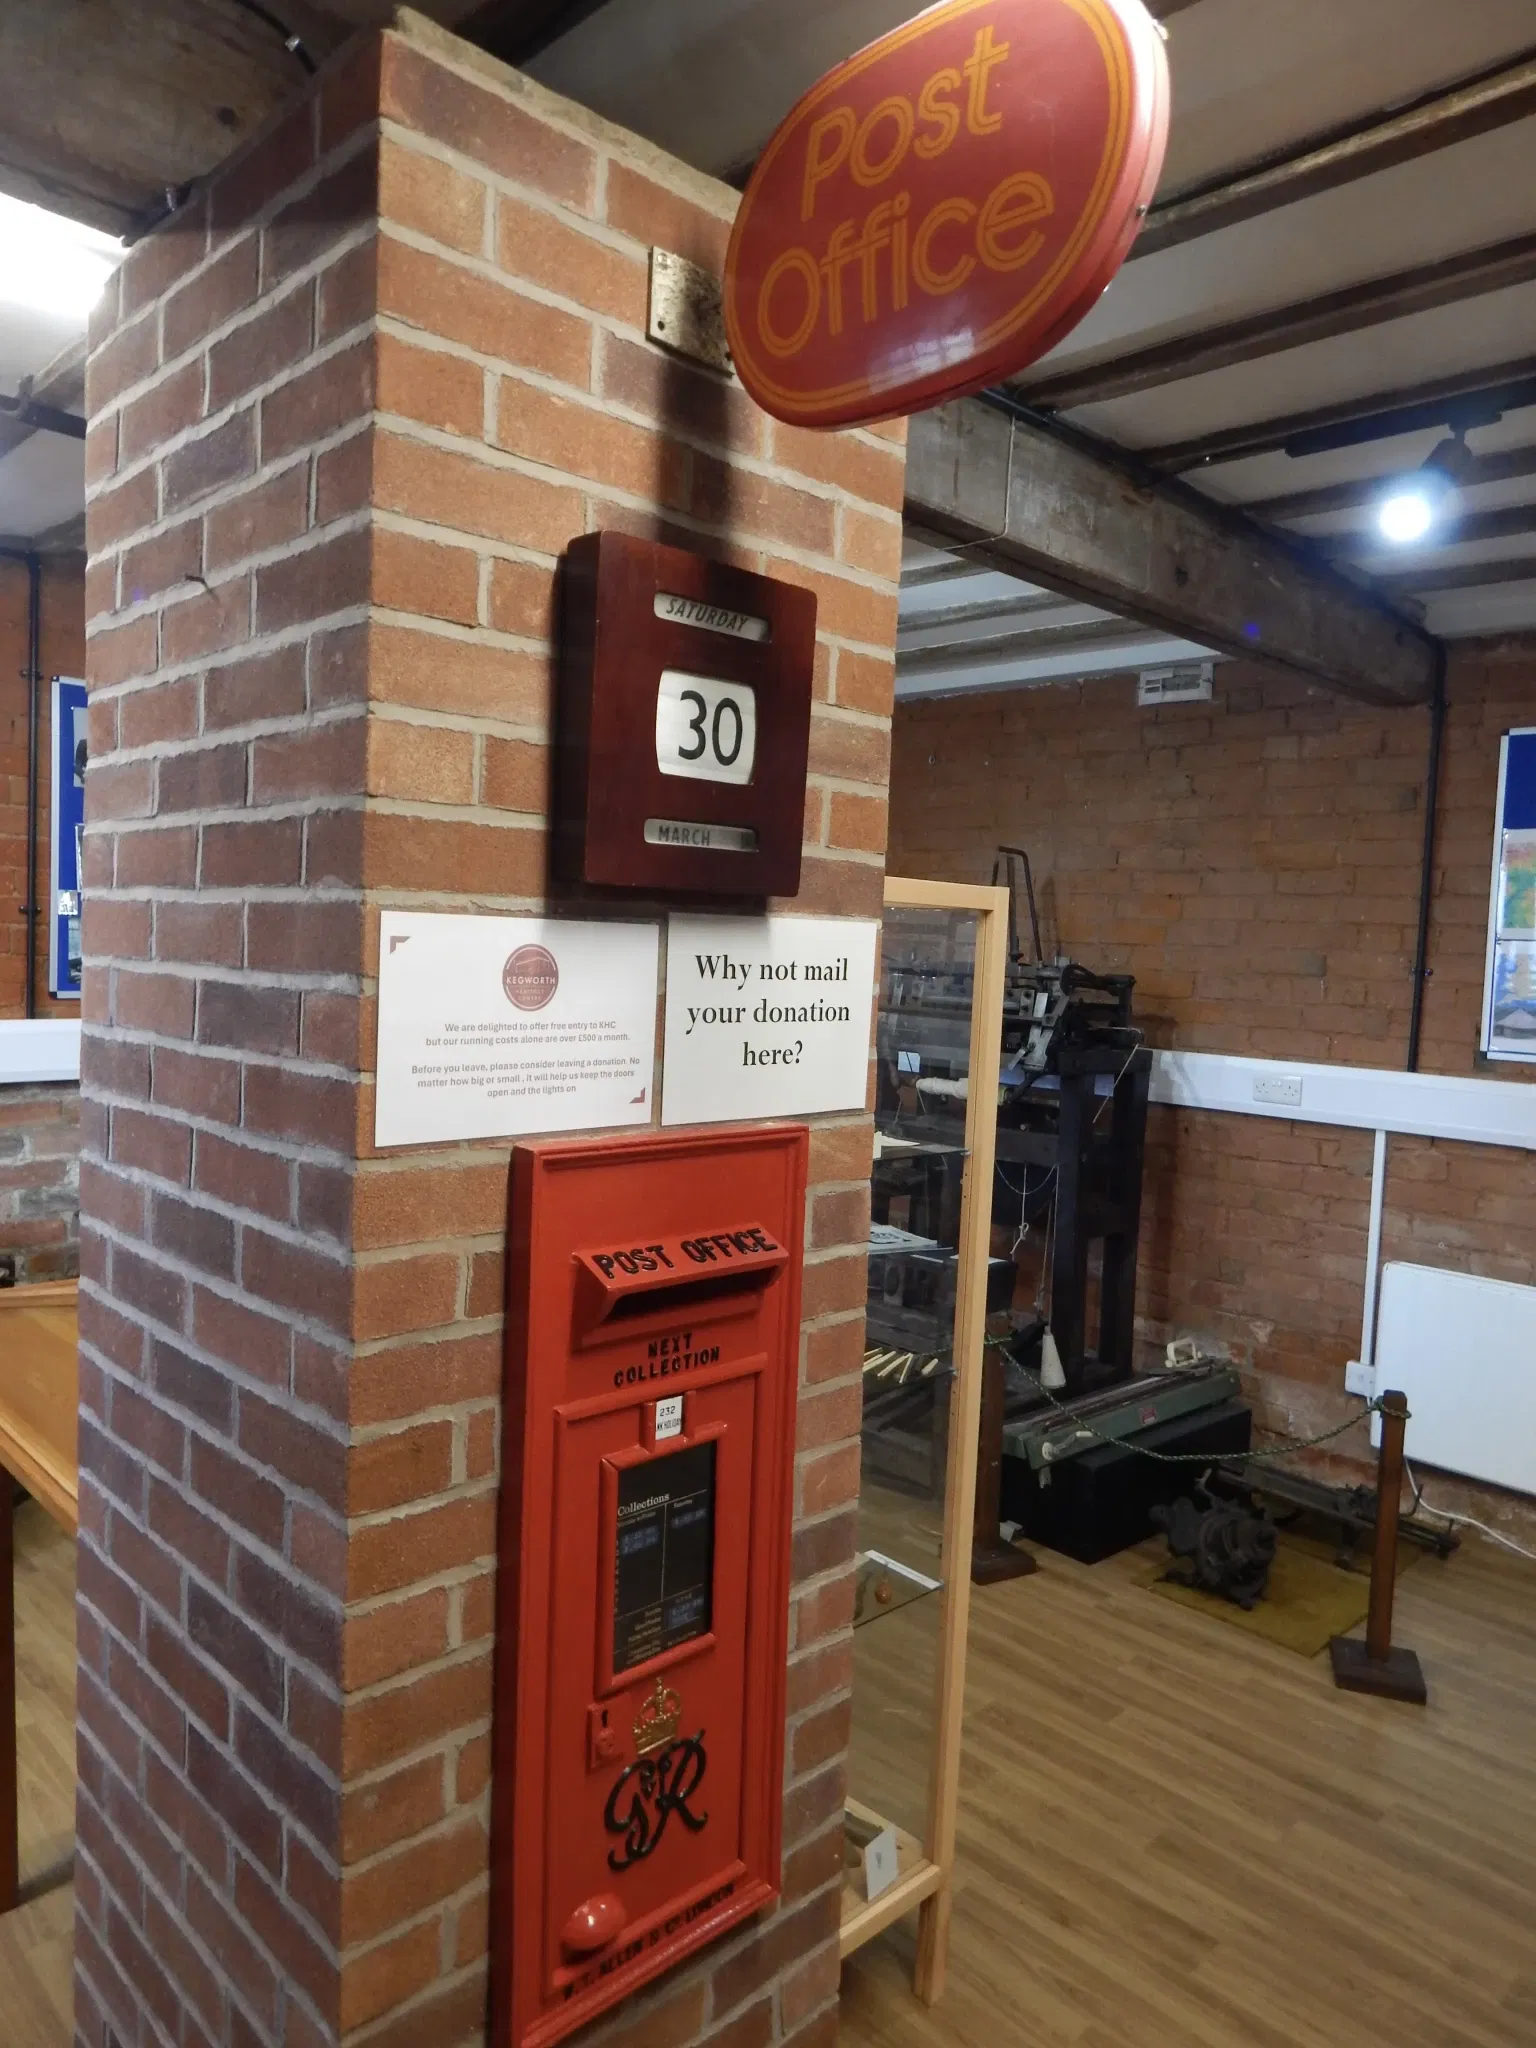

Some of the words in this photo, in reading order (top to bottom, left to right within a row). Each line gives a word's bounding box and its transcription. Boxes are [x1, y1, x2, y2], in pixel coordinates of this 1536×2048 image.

[802, 25, 1010, 222] Post
[757, 171, 1054, 357] Office
[666, 598, 748, 632] SATURDAY
[678, 690, 743, 766] 30
[658, 825, 711, 846] MARCH
[506, 976, 556, 985] KEGWORTH
[695, 954, 752, 991] Why
[759, 960, 798, 981] not
[804, 958, 848, 981] mail
[444, 1023, 460, 1032] We
[461, 1024, 476, 1032] are
[477, 1022, 518, 1033] delighted
[519, 1023, 528, 1031] to
[529, 1021, 549, 1030] offer
[550, 1021, 567, 1030] free
[567, 1022, 588, 1031] entry
[589, 1021, 598, 1029] to
[598, 1021, 617, 1029] KHC
[685, 1006, 746, 1035] your
[753, 998, 850, 1023] donation
[426, 1037, 441, 1046] but
[443, 1038, 458, 1046] our
[459, 1036, 494, 1046] running
[495, 1035, 519, 1044] costs
[520, 1035, 543, 1044] alone
[544, 1035, 557, 1043] are
[578, 1033, 596, 1042] £500
[411, 1065, 441, 1074] Before
[443, 1065, 460, 1074] you
[489, 1061, 518, 1072] please
[520, 1060, 555, 1069] consider
[557, 1059, 585, 1069] leaving
[629, 1056, 640, 1065] No
[742, 1040, 803, 1066] here?
[417, 1079, 448, 1088] matter
[450, 1077, 469, 1086] how
[470, 1076, 484, 1086] big
[526, 1074, 533, 1082] it
[533, 1073, 548, 1081] will
[549, 1072, 568, 1081] help
[579, 1071, 599, 1080] keep
[600, 1070, 612, 1078] the
[613, 1069, 635, 1077] doors
[487, 1089, 509, 1098] open
[510, 1087, 526, 1096] and
[527, 1086, 541, 1095] the
[542, 1085, 565, 1096] lights
[566, 1085, 576, 1093] on
[592, 1244, 674, 1280] POST
[680, 1227, 778, 1263] OFFICE
[648, 1332, 693, 1358] NEXT
[613, 1346, 721, 1388] COLLECTION
[617, 1493, 670, 1517] Collections
